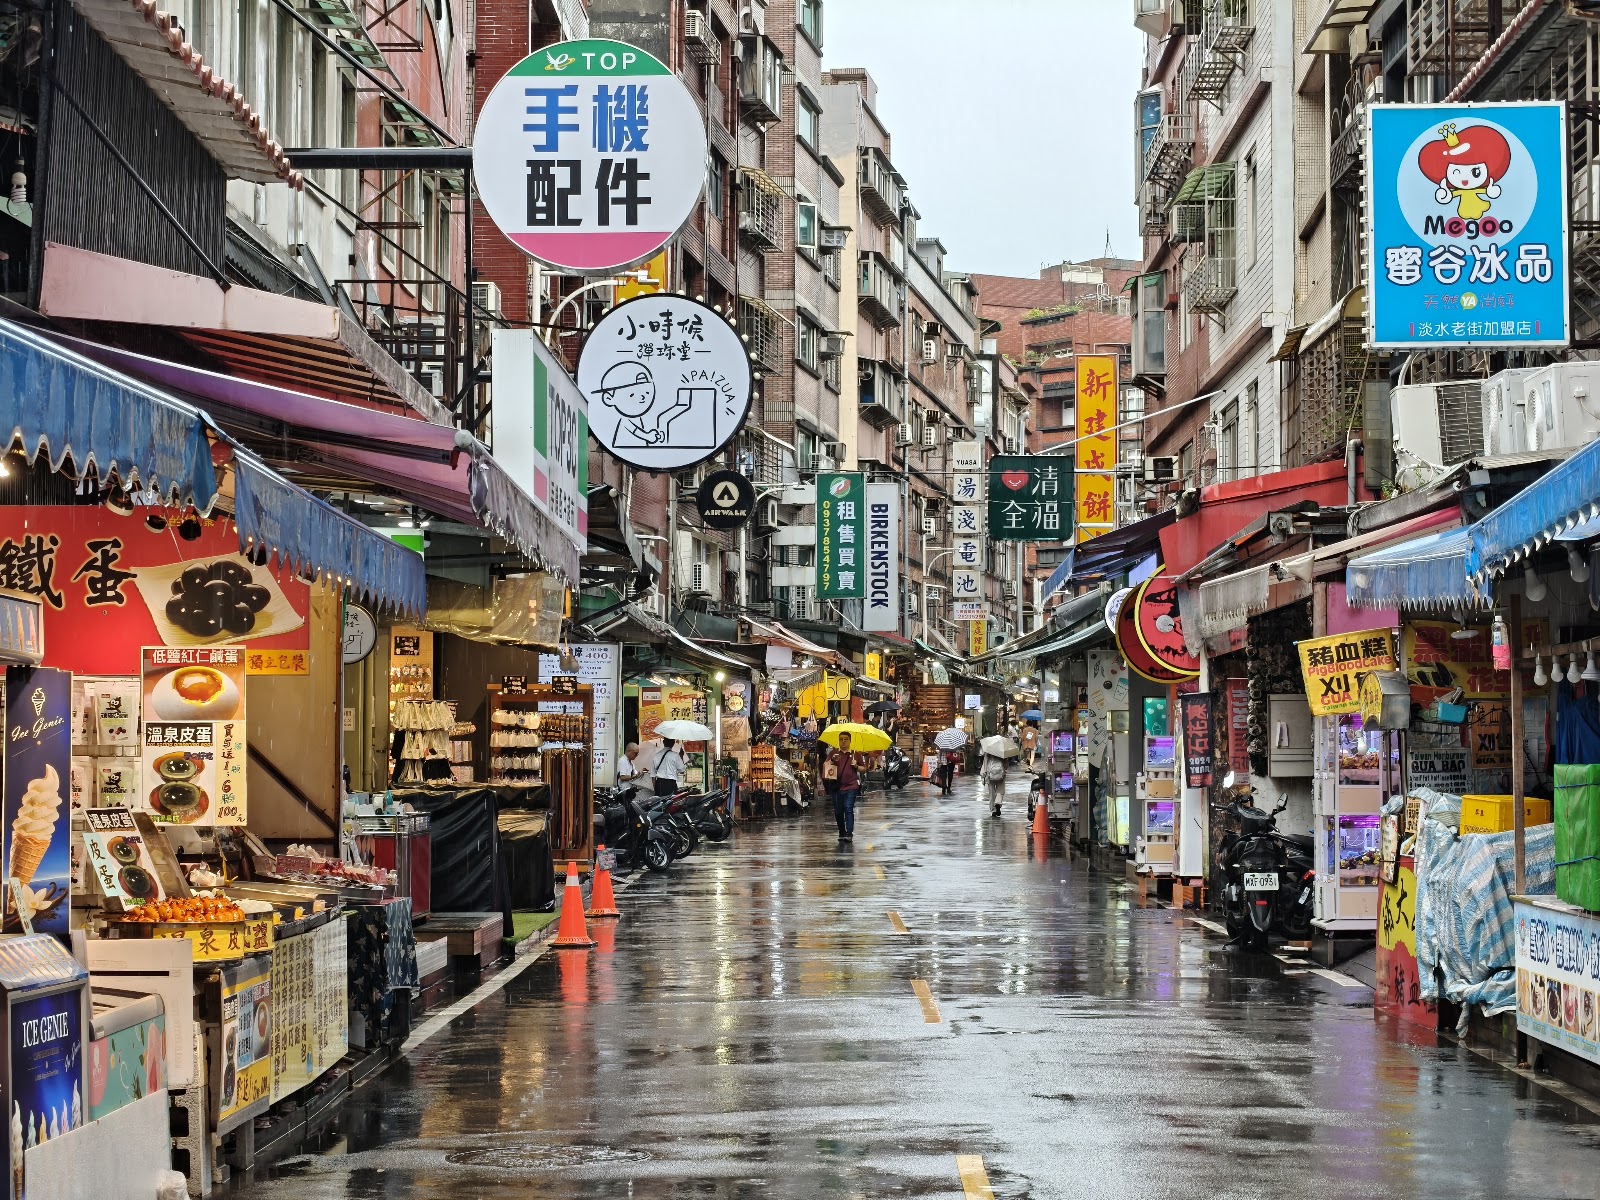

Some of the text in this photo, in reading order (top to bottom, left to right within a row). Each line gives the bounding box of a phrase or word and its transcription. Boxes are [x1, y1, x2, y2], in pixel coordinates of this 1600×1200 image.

[582, 52, 637, 70] TOP
[523, 84, 649, 153] 手機
[526, 157, 651, 227] 配件
[1424, 214, 1513, 240] Megoo
[1385, 243, 1553, 286] 蜜谷冰品
[1423, 294, 1459, 309] 天然
[617, 309, 704, 342] 小時候
[1418, 320, 1532, 337] 淡水老街加盟店
[636, 341, 691, 361] 彈珠堂
[703, 509, 747, 517] AIRWALK
[822, 500, 831, 591] 0937854797
[837, 500, 857, 591] 租售買賣
[870, 503, 889, 609] BIRKENSTOCK
[0, 534, 138, 609] 鐵蛋
[153, 649, 239, 664] 低鹽紅仁鹹蛋
[248, 655, 307, 672] 獨立包裝
[1307, 637, 1389, 668] 豬血糕
[1320, 692, 1352, 706] GUA
[147, 726, 212, 743] 溫泉皮蛋
[1411, 760, 1437, 773] GUA
[89, 812, 133, 829] 溫泉皮蛋
[22, 1011, 69, 1048] ICE GENIE
